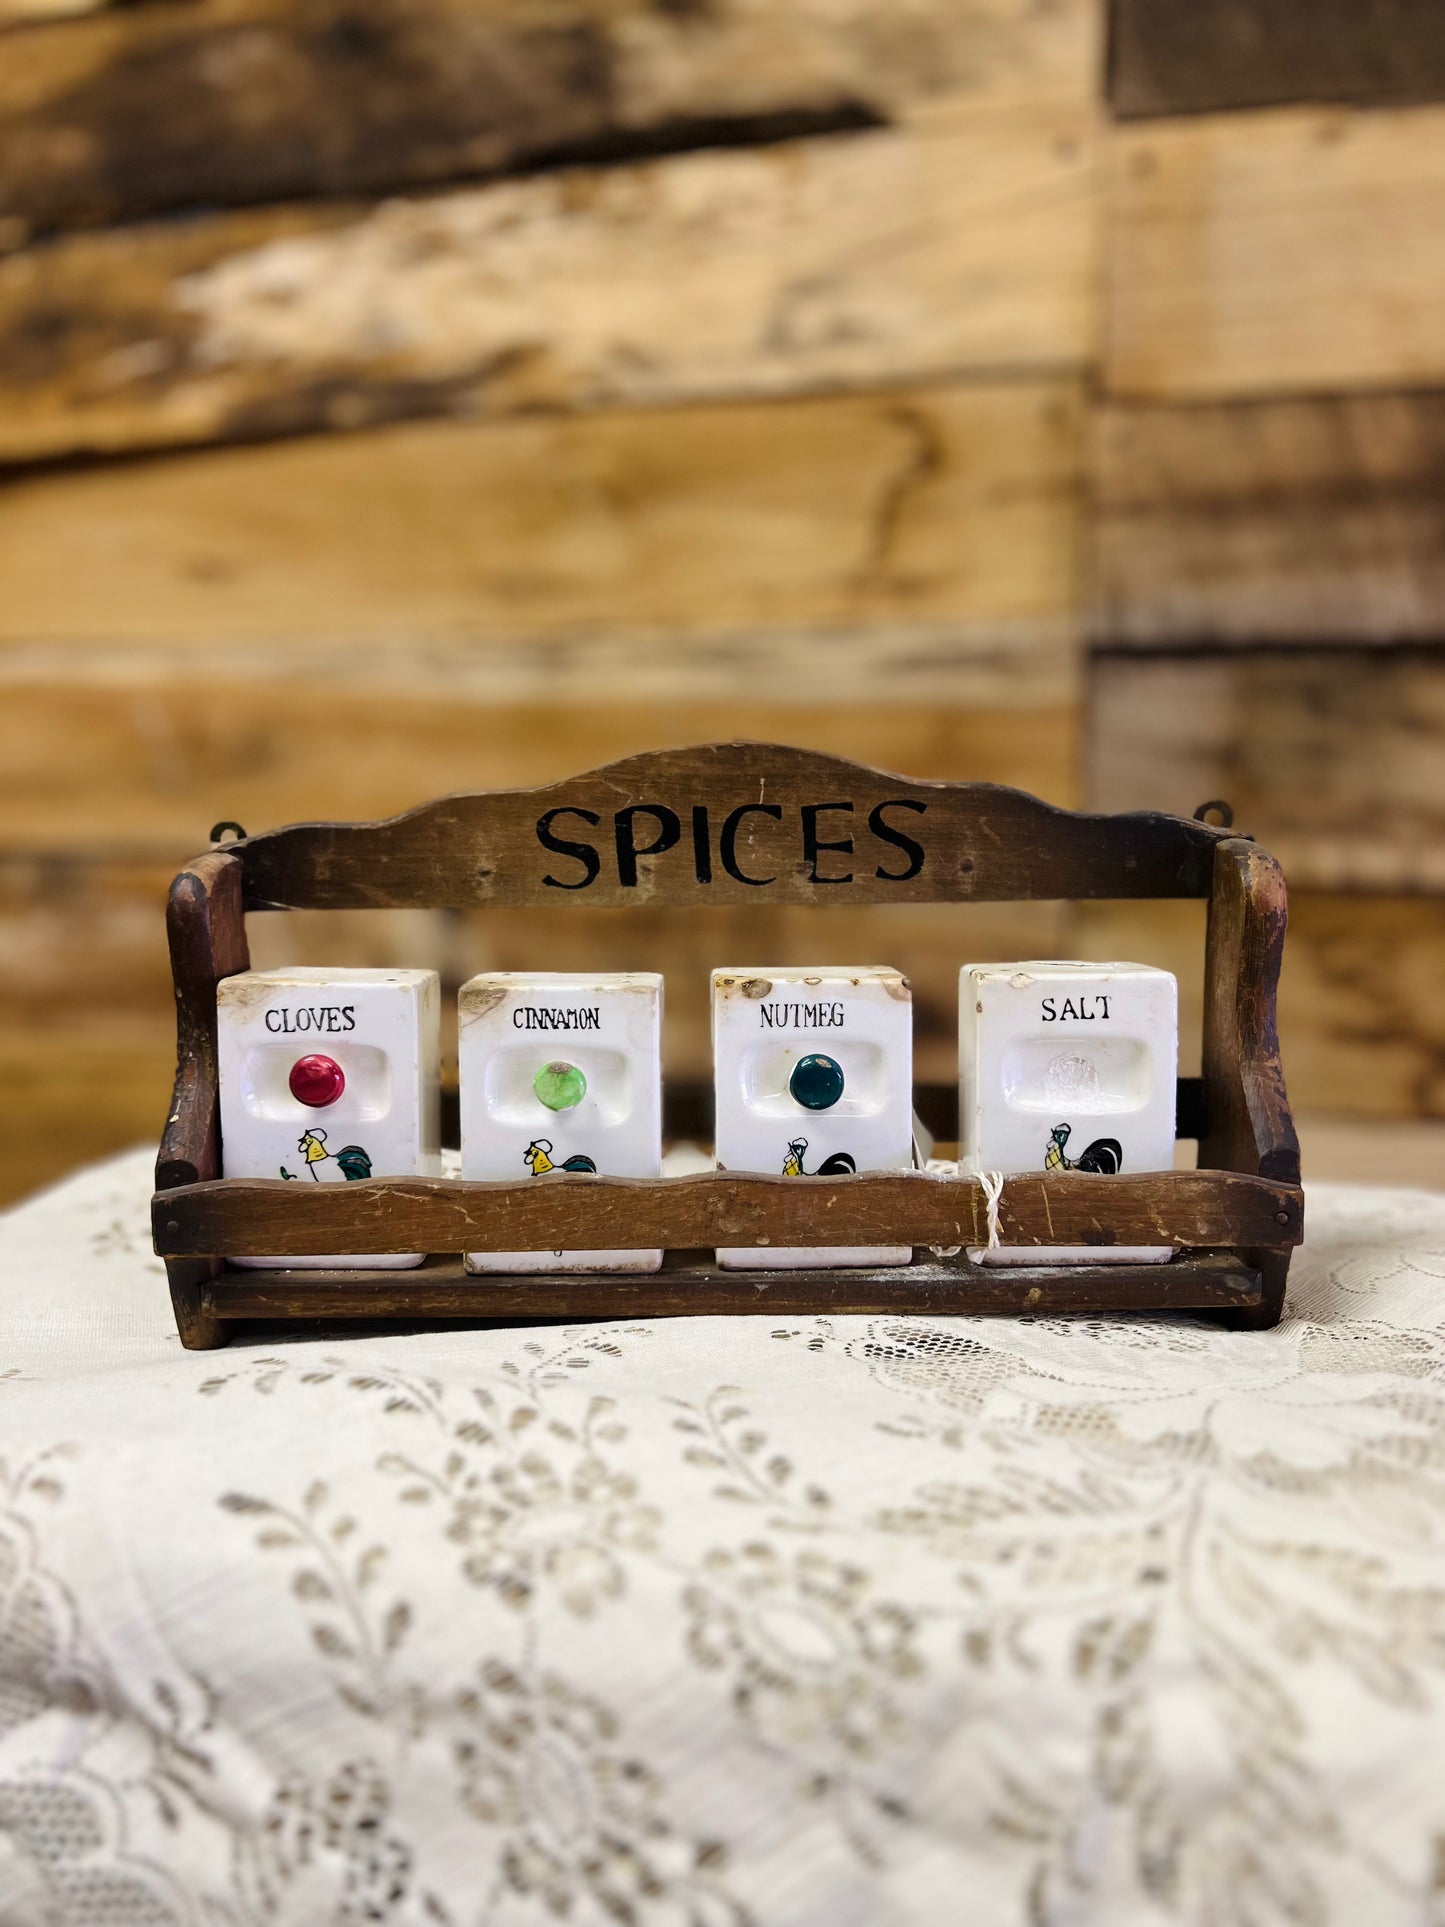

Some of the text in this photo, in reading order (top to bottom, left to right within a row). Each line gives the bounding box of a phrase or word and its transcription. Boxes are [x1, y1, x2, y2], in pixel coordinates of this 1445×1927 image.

[536, 800, 928, 890] SPICES
[265, 1006, 356, 1032] CLOVES
[513, 1006, 601, 1030] CINNAMON
[760, 1002, 845, 1029] NUTMEG
[1041, 995, 1112, 1022] SALT
